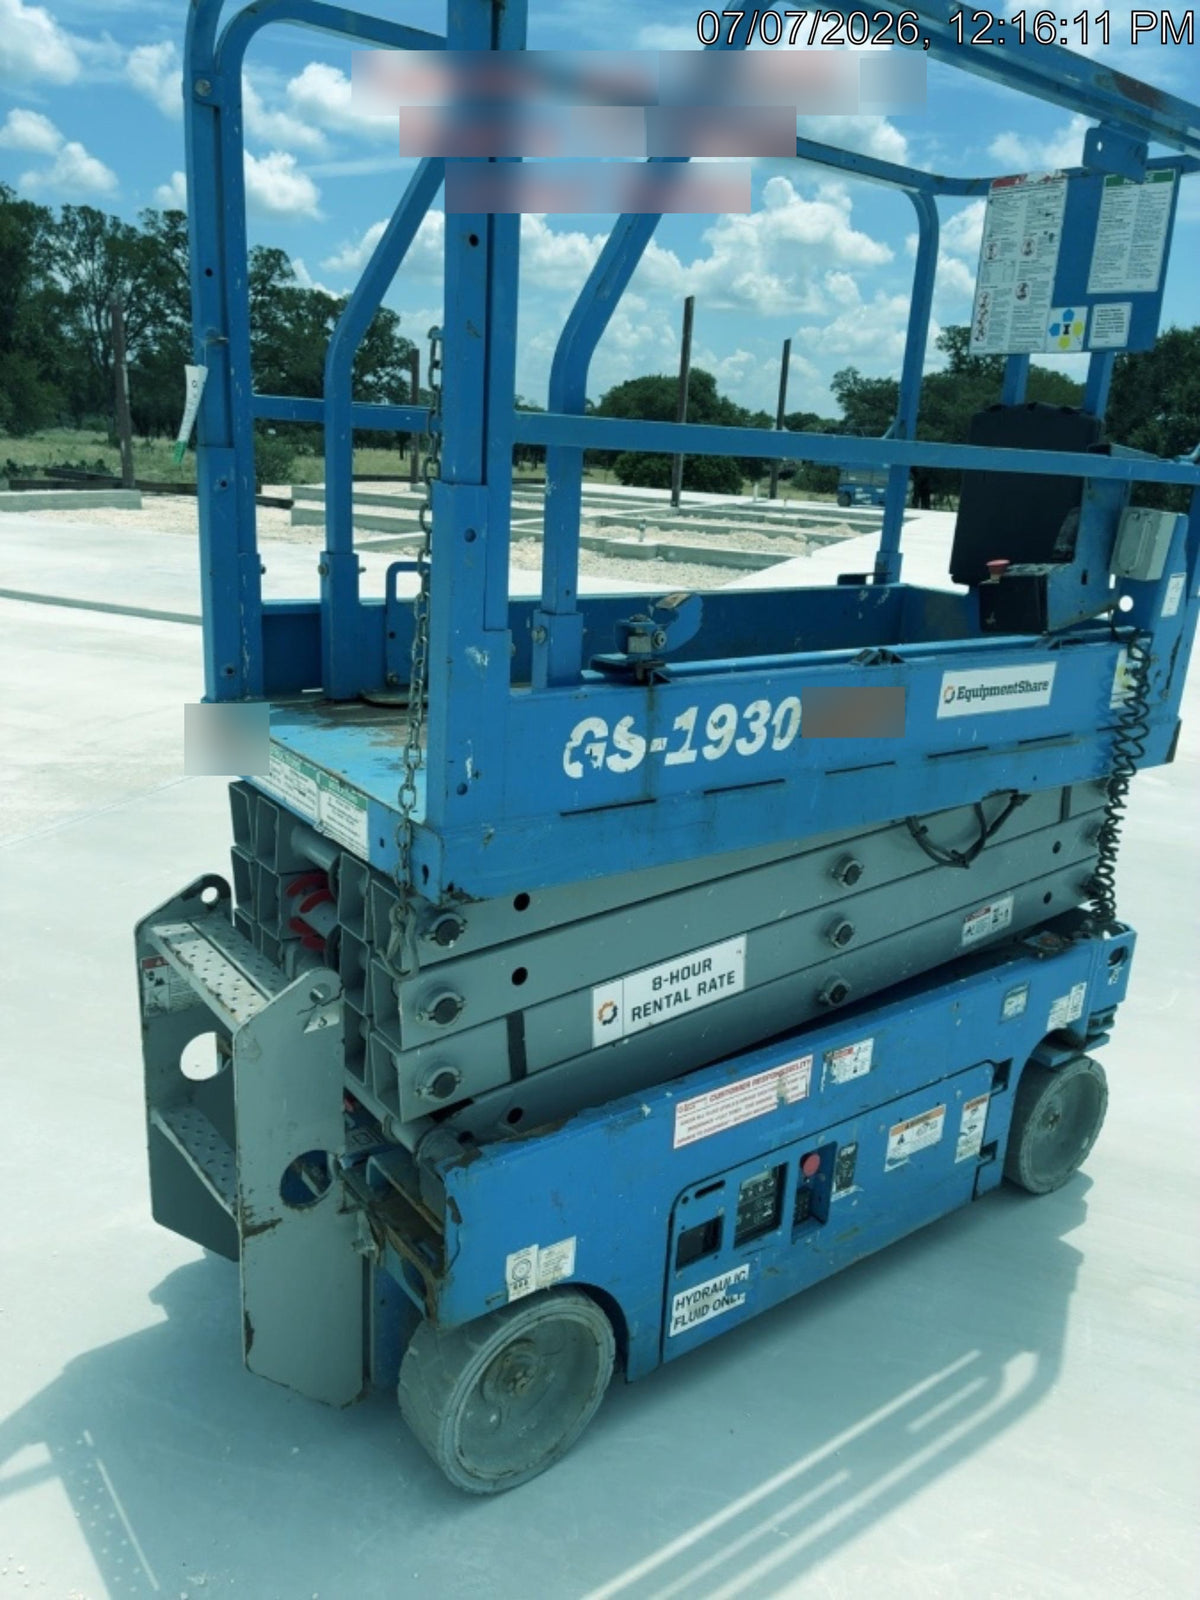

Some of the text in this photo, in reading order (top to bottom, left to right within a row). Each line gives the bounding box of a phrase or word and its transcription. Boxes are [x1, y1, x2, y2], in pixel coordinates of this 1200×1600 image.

[956, 680, 1049, 702] EquipmentShare
[563, 696, 802, 779] GS-1930
[652, 957, 713, 991] 8-HOUR
[631, 970, 735, 1022] RENTAL RATE
[708, 1080, 751, 1103] CUSTOMER
[673, 1304, 710, 1331] FLUID
